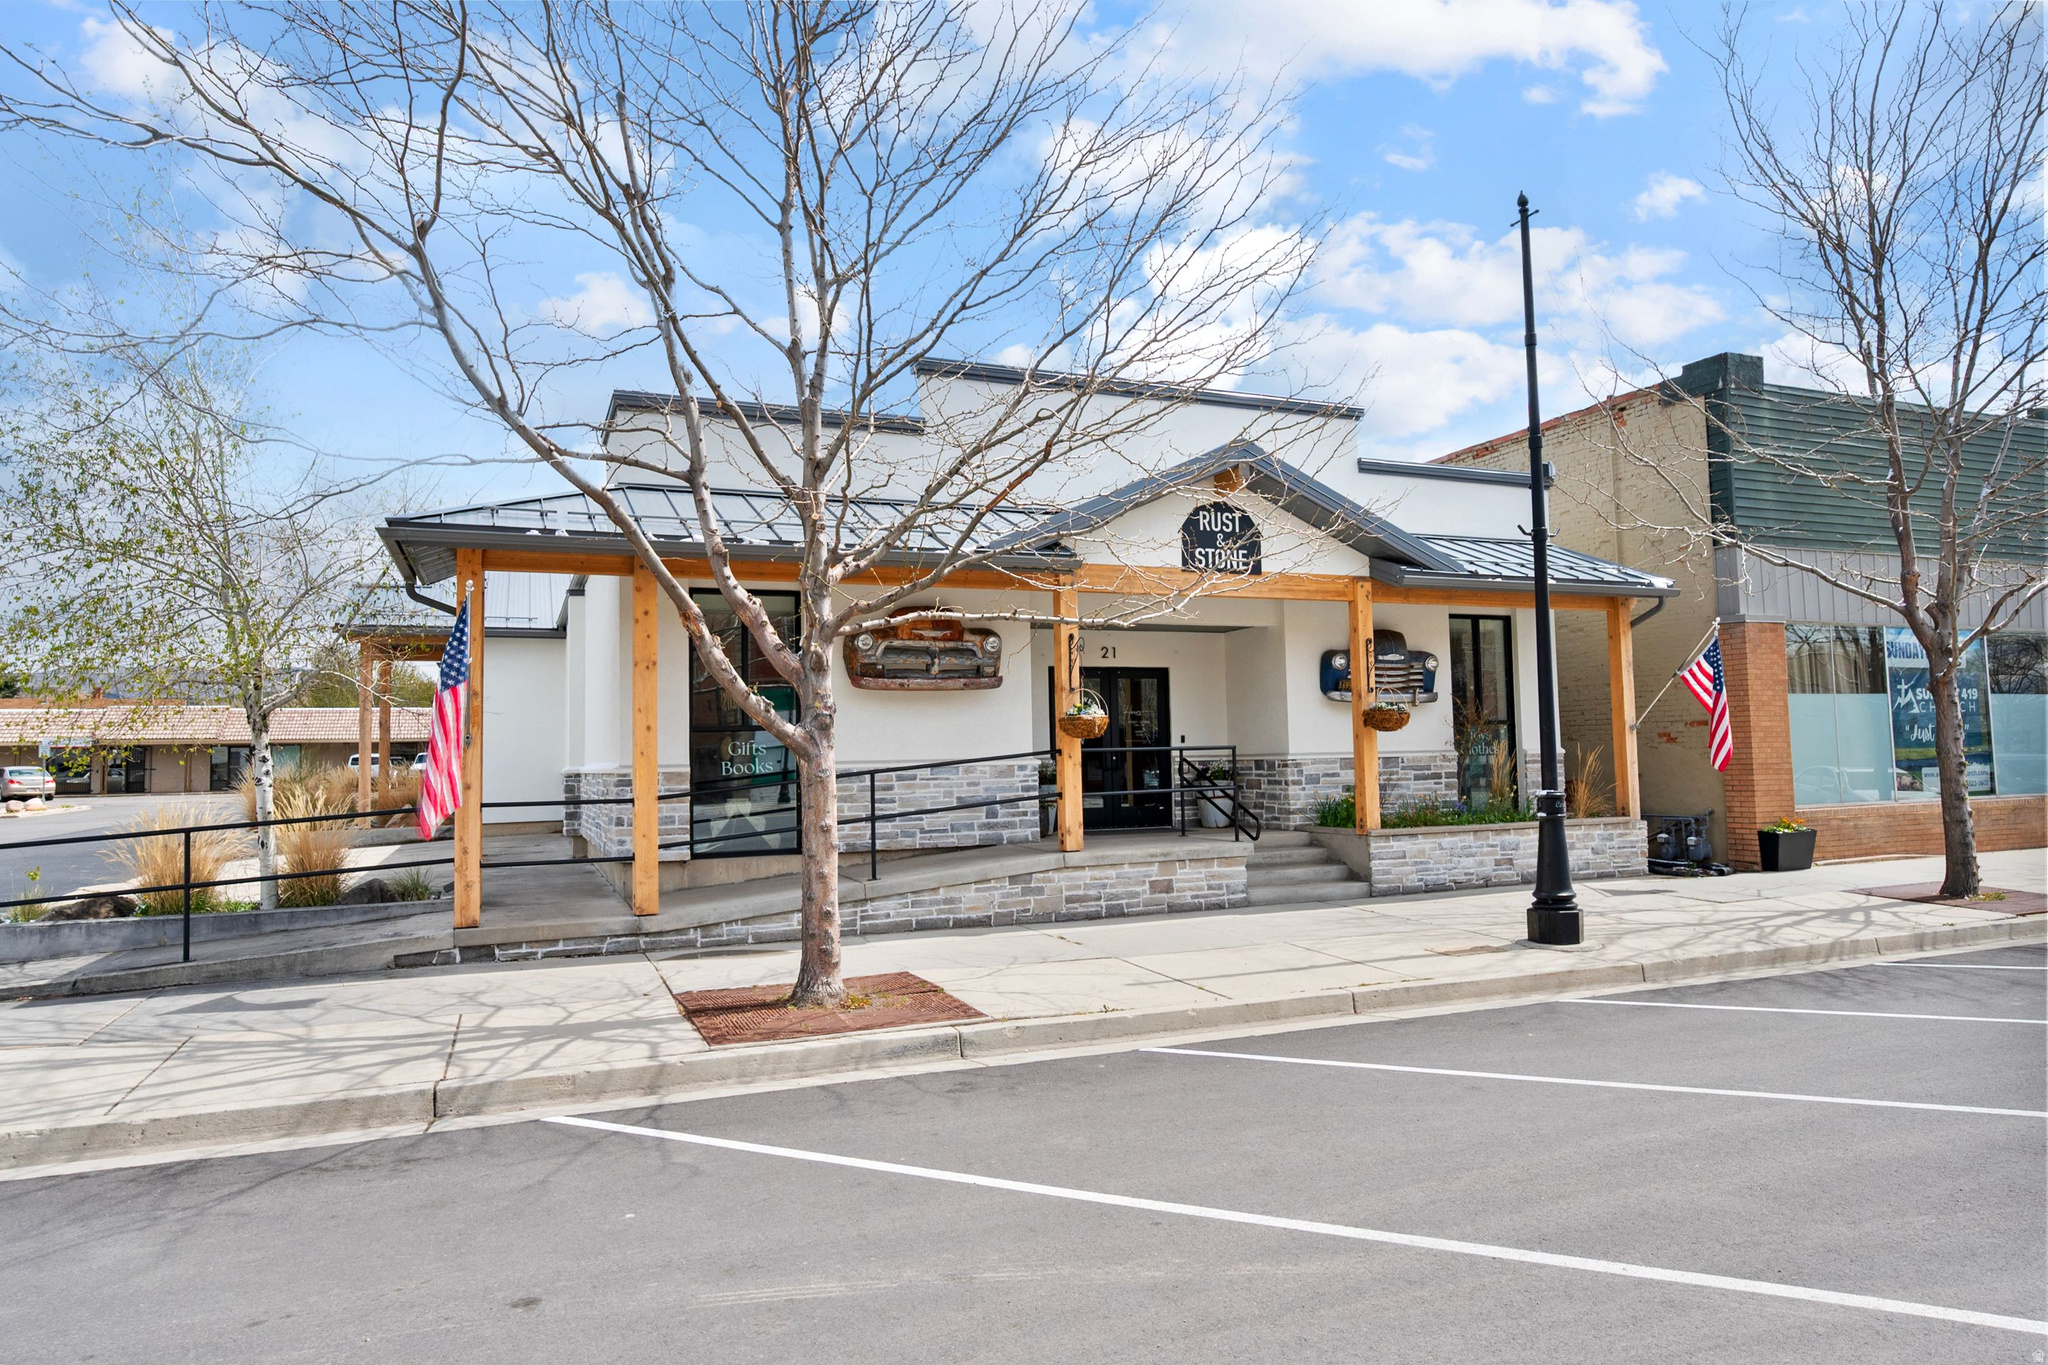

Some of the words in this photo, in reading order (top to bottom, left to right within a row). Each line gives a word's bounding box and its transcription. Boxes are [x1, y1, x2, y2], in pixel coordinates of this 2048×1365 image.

[1199, 510, 1242, 533] RUST
[1216, 533, 1226, 547] &
[1195, 547, 1249, 570] STONE
[1101, 646, 1116, 659] 21
[1961, 688, 1978, 700] 419
[1920, 701, 1976, 713] CHCH
[728, 740, 767, 756] Gifts
[721, 758, 774, 776] Books
